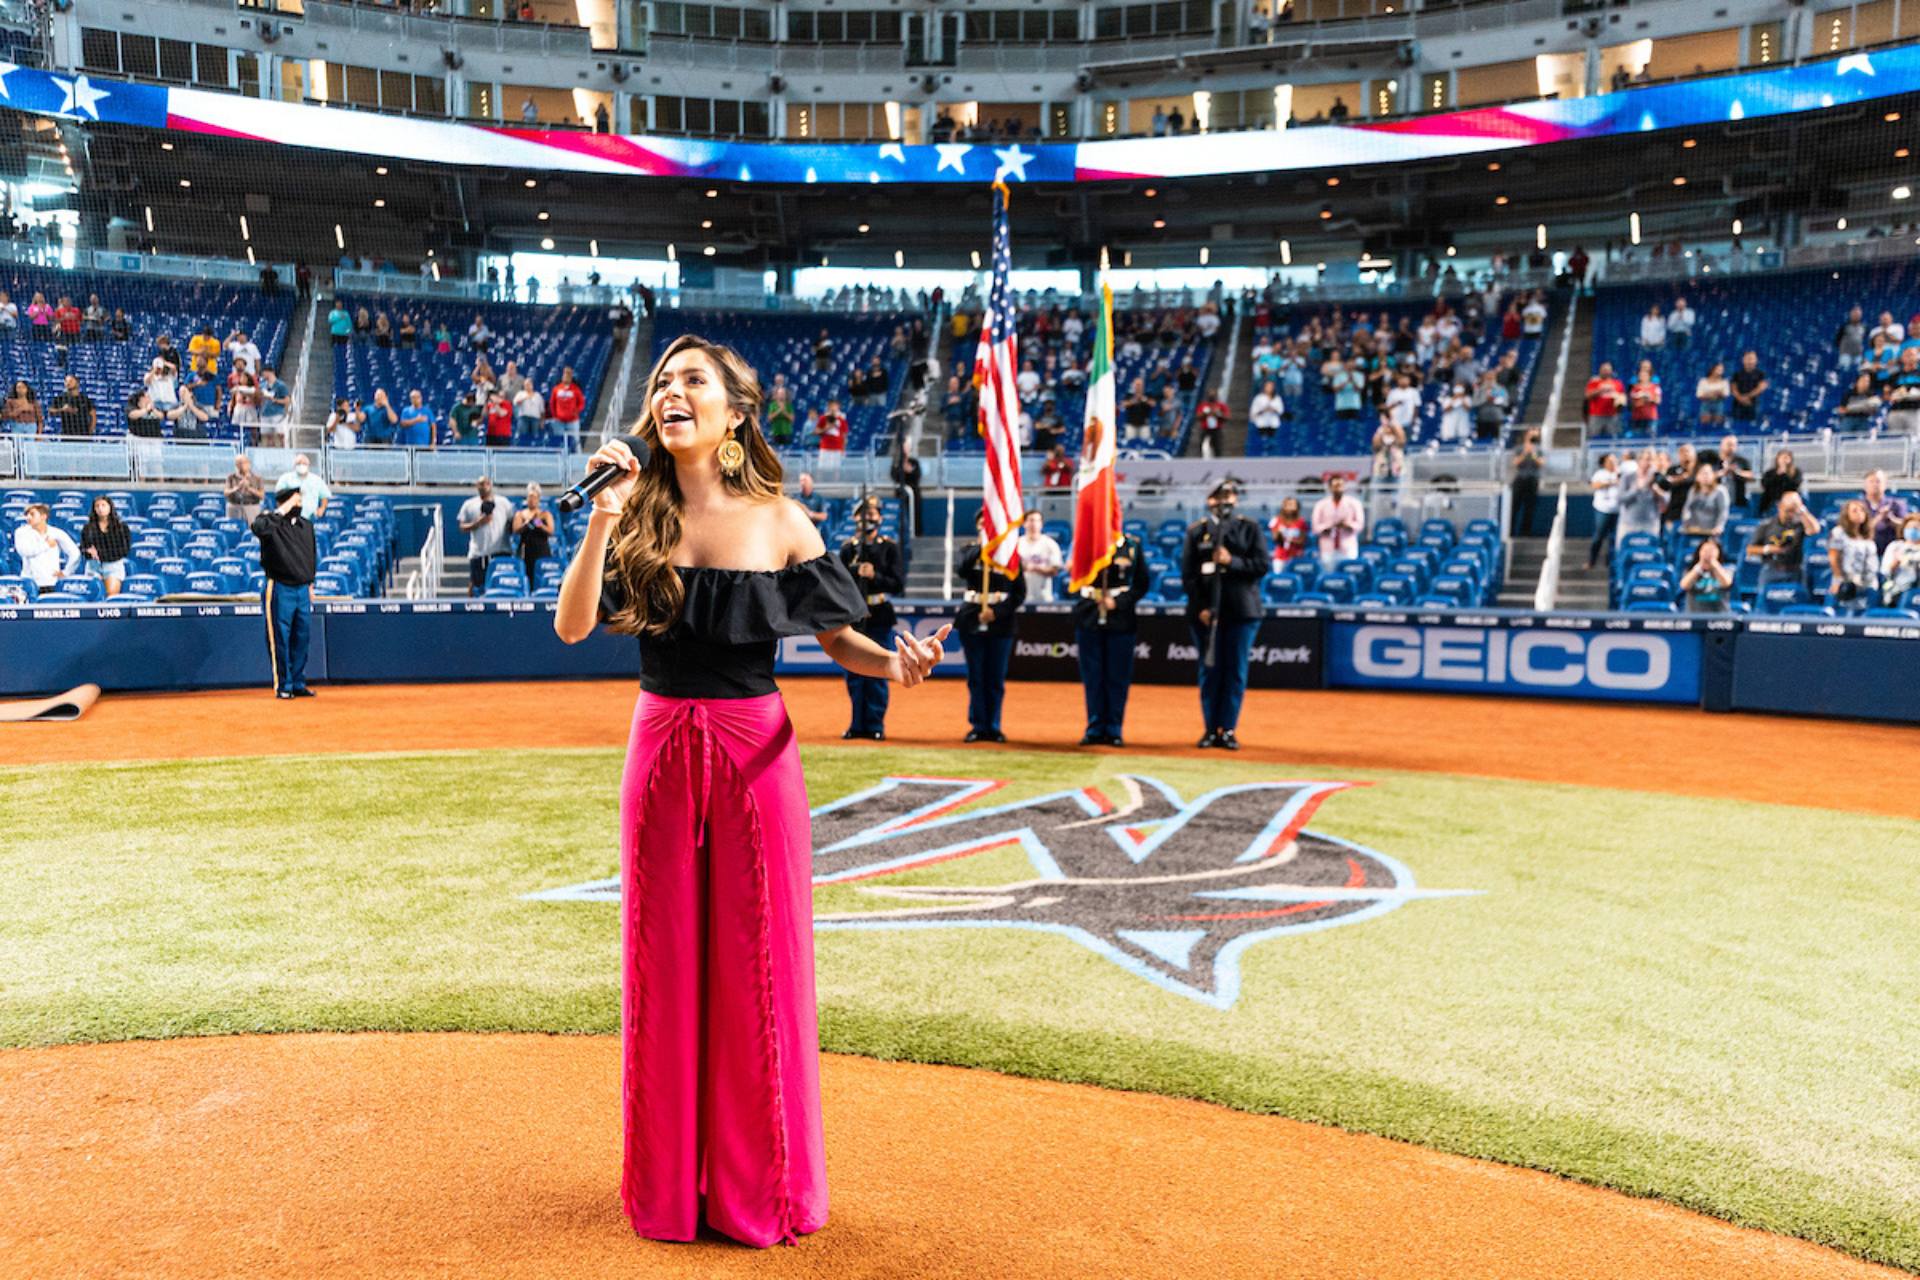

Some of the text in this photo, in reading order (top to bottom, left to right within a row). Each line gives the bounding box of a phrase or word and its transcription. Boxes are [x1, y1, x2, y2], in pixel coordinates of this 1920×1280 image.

[0, 610, 18, 619] KG
[33, 609, 81, 619] MARLINS.COM
[97, 608, 121, 617] UKG
[137, 607, 182, 617] MARLINS.COM
[198, 607, 221, 616] UKG
[1015, 640, 1081, 658] loanDe
[1266, 645, 1311, 665] park
[1352, 626, 1671, 690] GEICO
